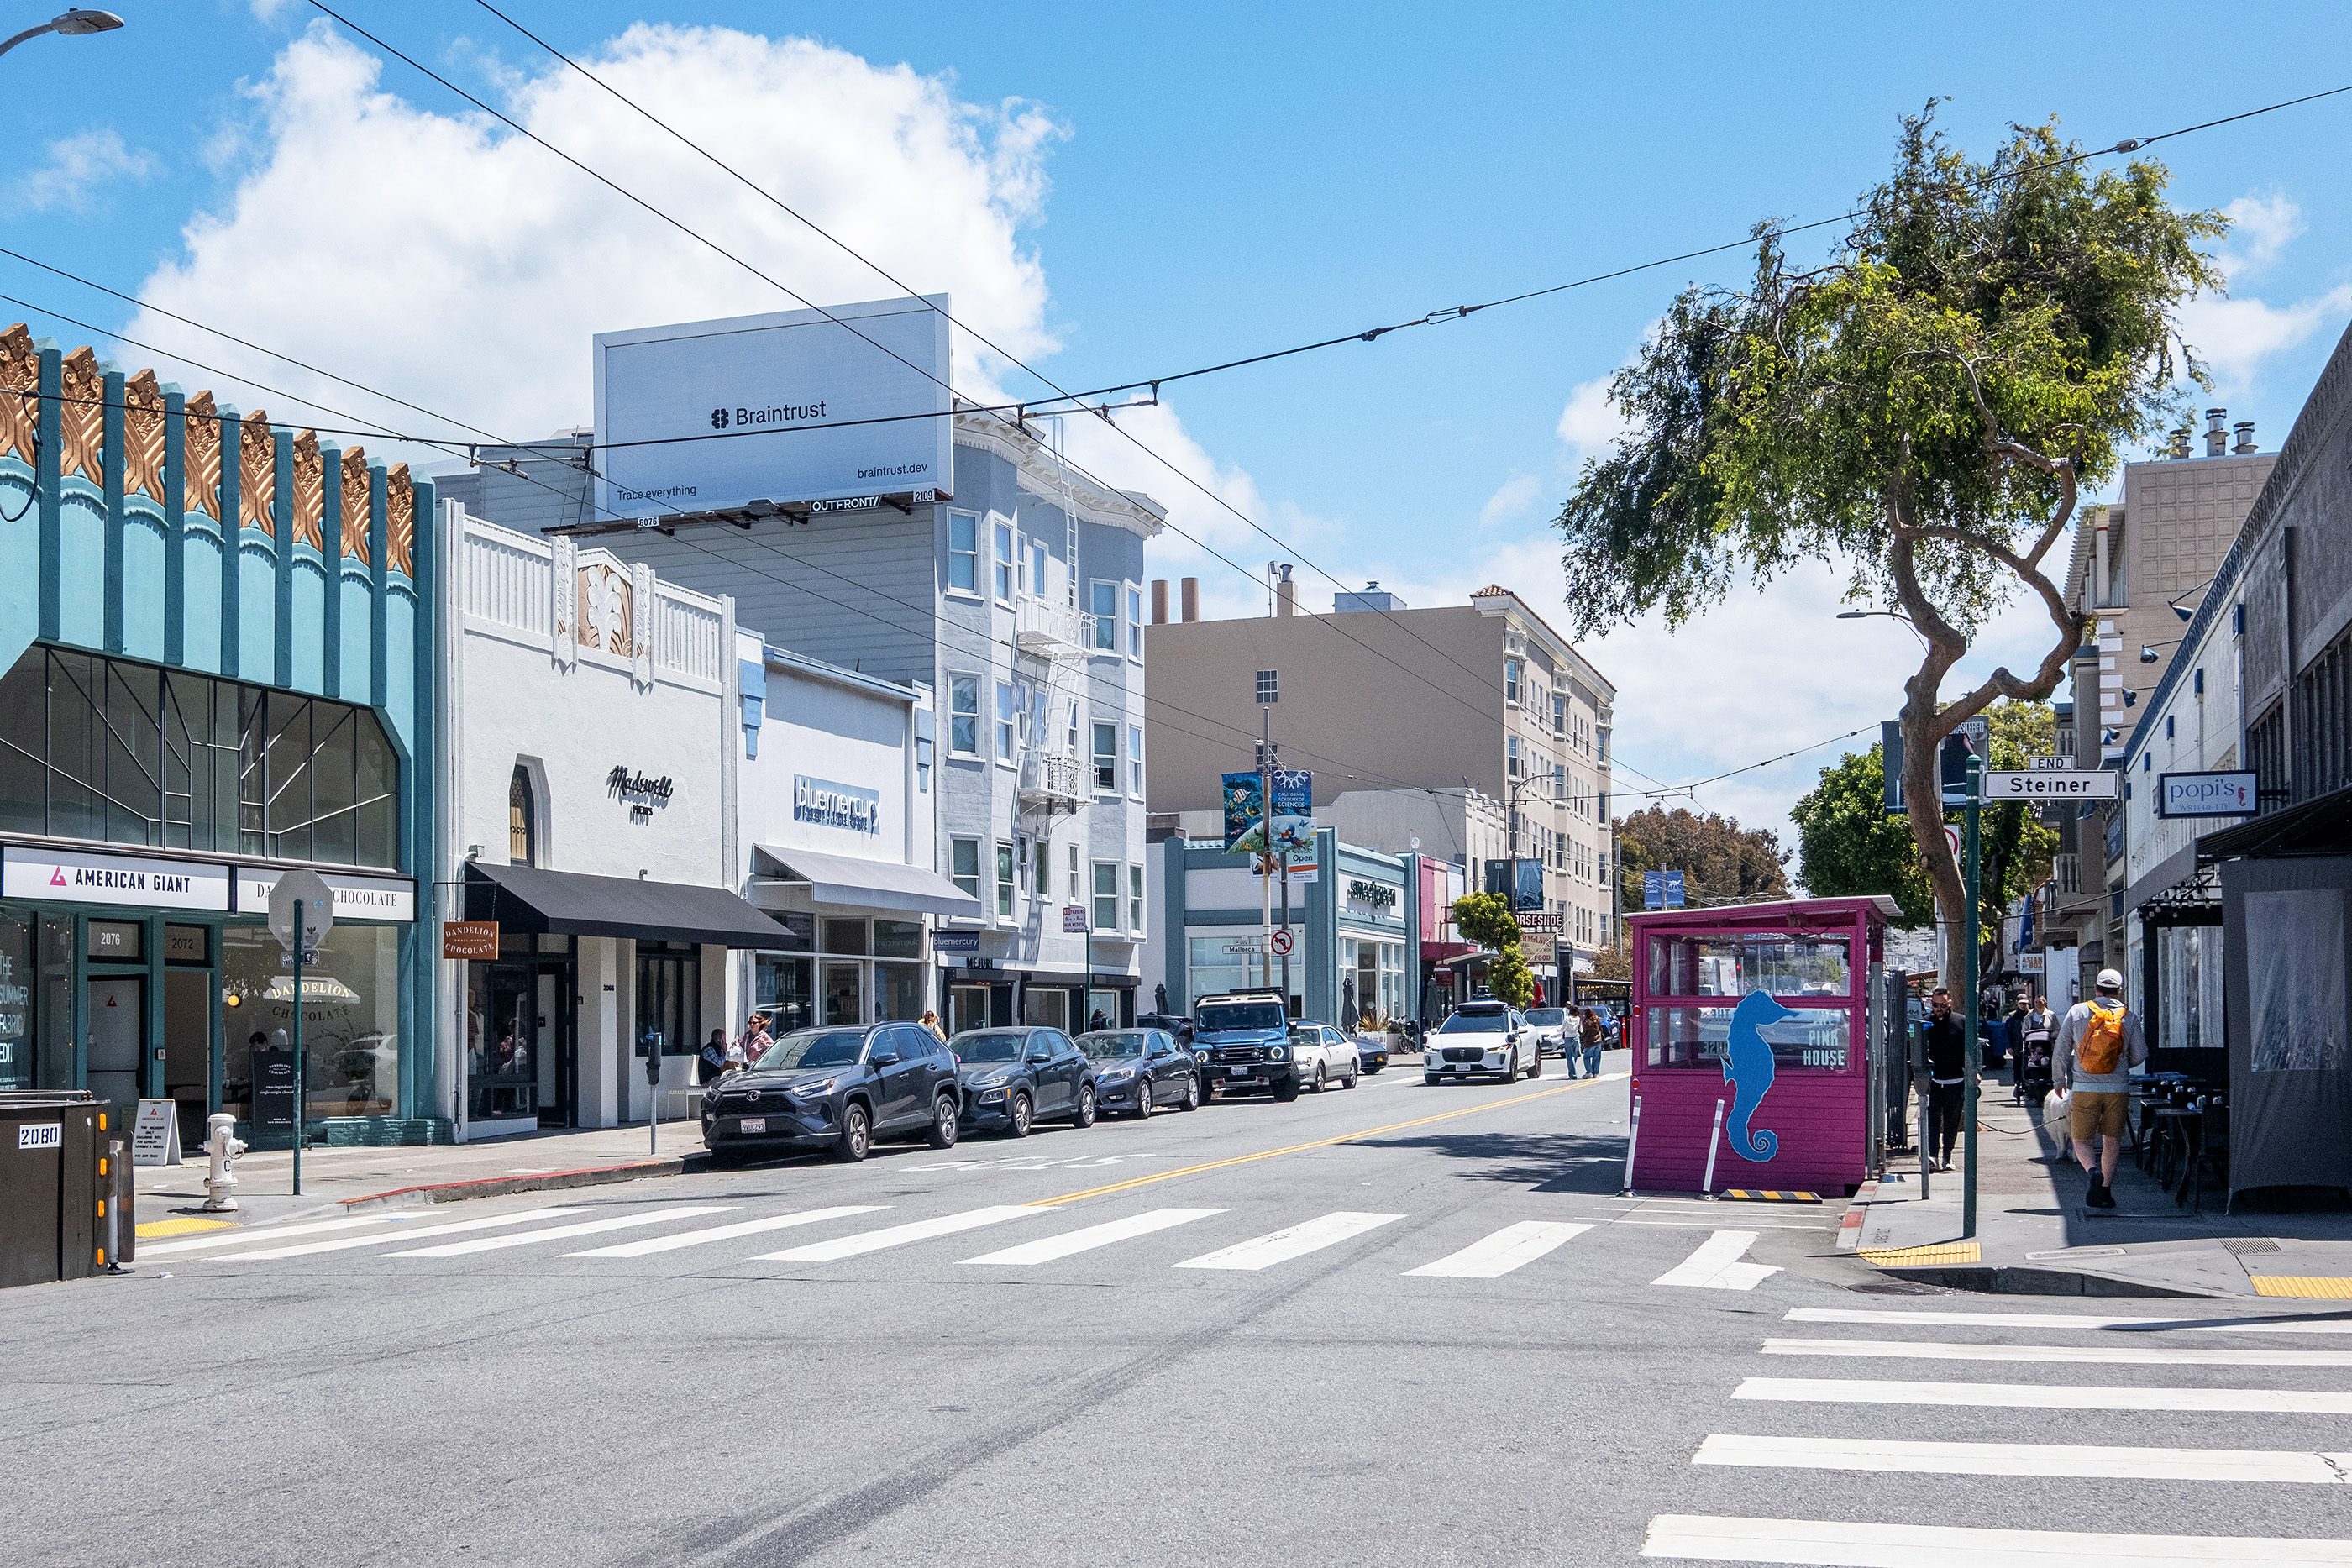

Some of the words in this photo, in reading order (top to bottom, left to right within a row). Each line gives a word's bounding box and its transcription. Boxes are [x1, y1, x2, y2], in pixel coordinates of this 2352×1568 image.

[736, 401, 826, 425] Braintrust
[858, 463, 927, 479] braintrust.dev
[617, 490, 643, 501] Trace
[645, 485, 696, 499] everything
[915, 490, 933, 501] 2109
[638, 517, 658, 527] 6076
[2038, 758, 2064, 768] END
[608, 765, 674, 798] Madewell
[2009, 777, 2091, 793] Steiner
[2170, 779, 2234, 803] popi's
[797, 777, 881, 827] bluemercury
[1293, 854, 1313, 863] Open
[75, 868, 144, 890] AMERICAN
[153, 875, 191, 894] GIANT
[333, 889, 397, 907] CHOCOLATE
[1350, 880, 1396, 909] sweetgreen
[101, 932, 120, 946] 2076
[445, 926, 495, 938] DANDELION
[171, 937, 193, 950] 2072
[445, 943, 494, 955] CHOCOLATE
[934, 936, 979, 947] bluemercury
[966, 957, 993, 968] MEJURI
[0, 983, 29, 1005] SUMMER
[1809, 1029, 1839, 1046] PINK
[1803, 1050, 1845, 1066] HOUSE
[20, 1126, 58, 1146] 2080
